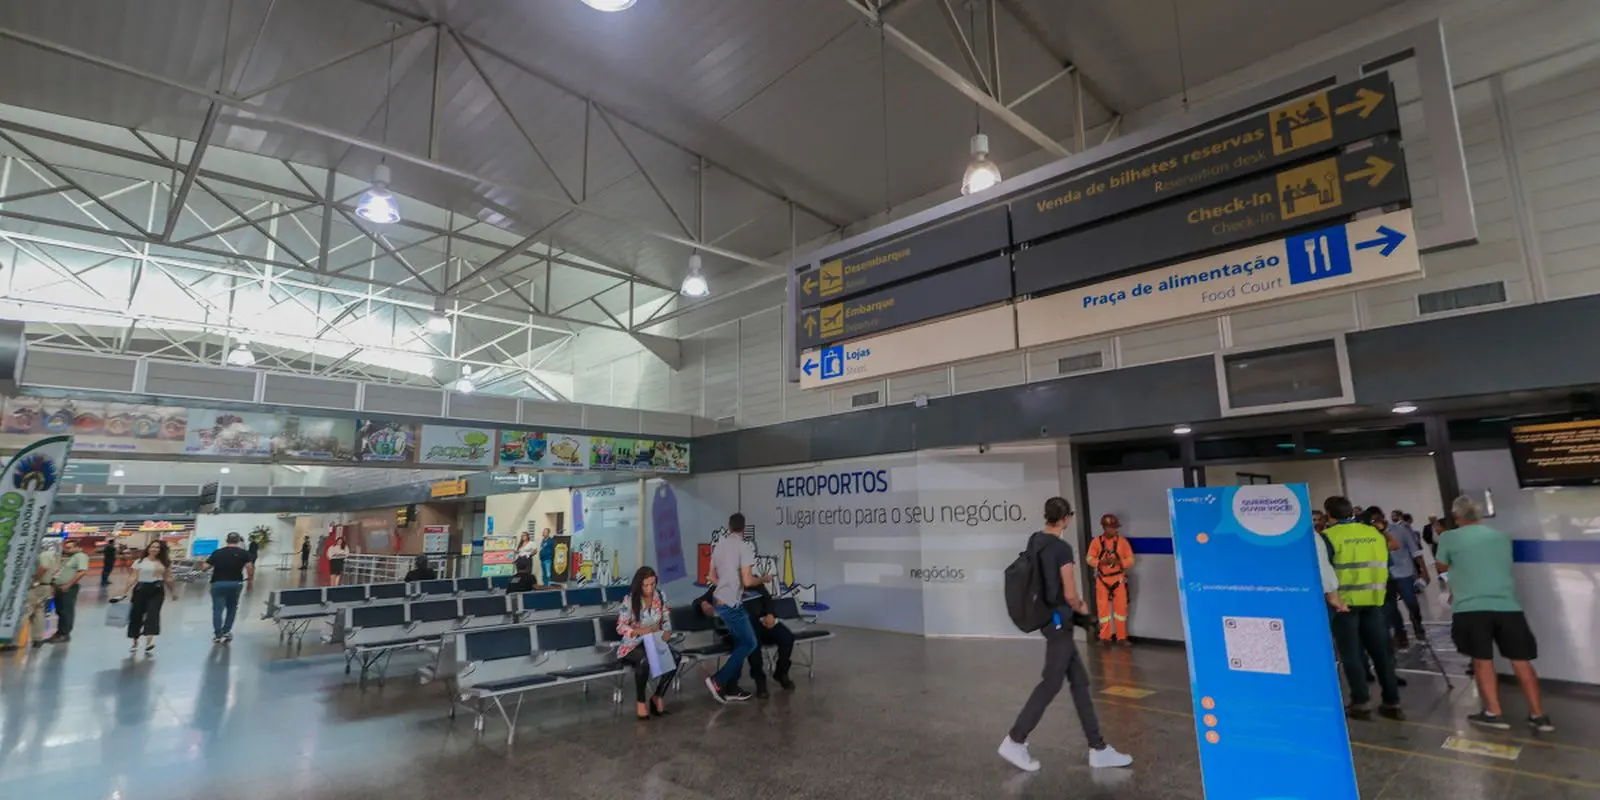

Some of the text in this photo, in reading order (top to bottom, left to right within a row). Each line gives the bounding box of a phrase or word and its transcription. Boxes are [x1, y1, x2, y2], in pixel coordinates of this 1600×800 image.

[1037, 127, 1265, 213] Venda de bilhetes reservas
[1155, 150, 1268, 192] Reservation desk
[1186, 191, 1273, 225] Check-In
[1211, 211, 1276, 236] Check-In
[845, 248, 911, 274] Desembarque
[1083, 255, 1281, 308] Praça de alimentação
[1201, 277, 1284, 304] Food Court
[846, 299, 895, 317] Embarque
[846, 348, 871, 361] Lojas
[775, 470, 888, 498] AEROPORTOS
[785, 506, 817, 529] lugar
[818, 507, 852, 526] certo
[855, 507, 887, 528] para
[891, 508, 901, 524] o
[904, 506, 935, 525] seu
[940, 496, 1027, 527] negócio.
[910, 565, 965, 582] negócios
